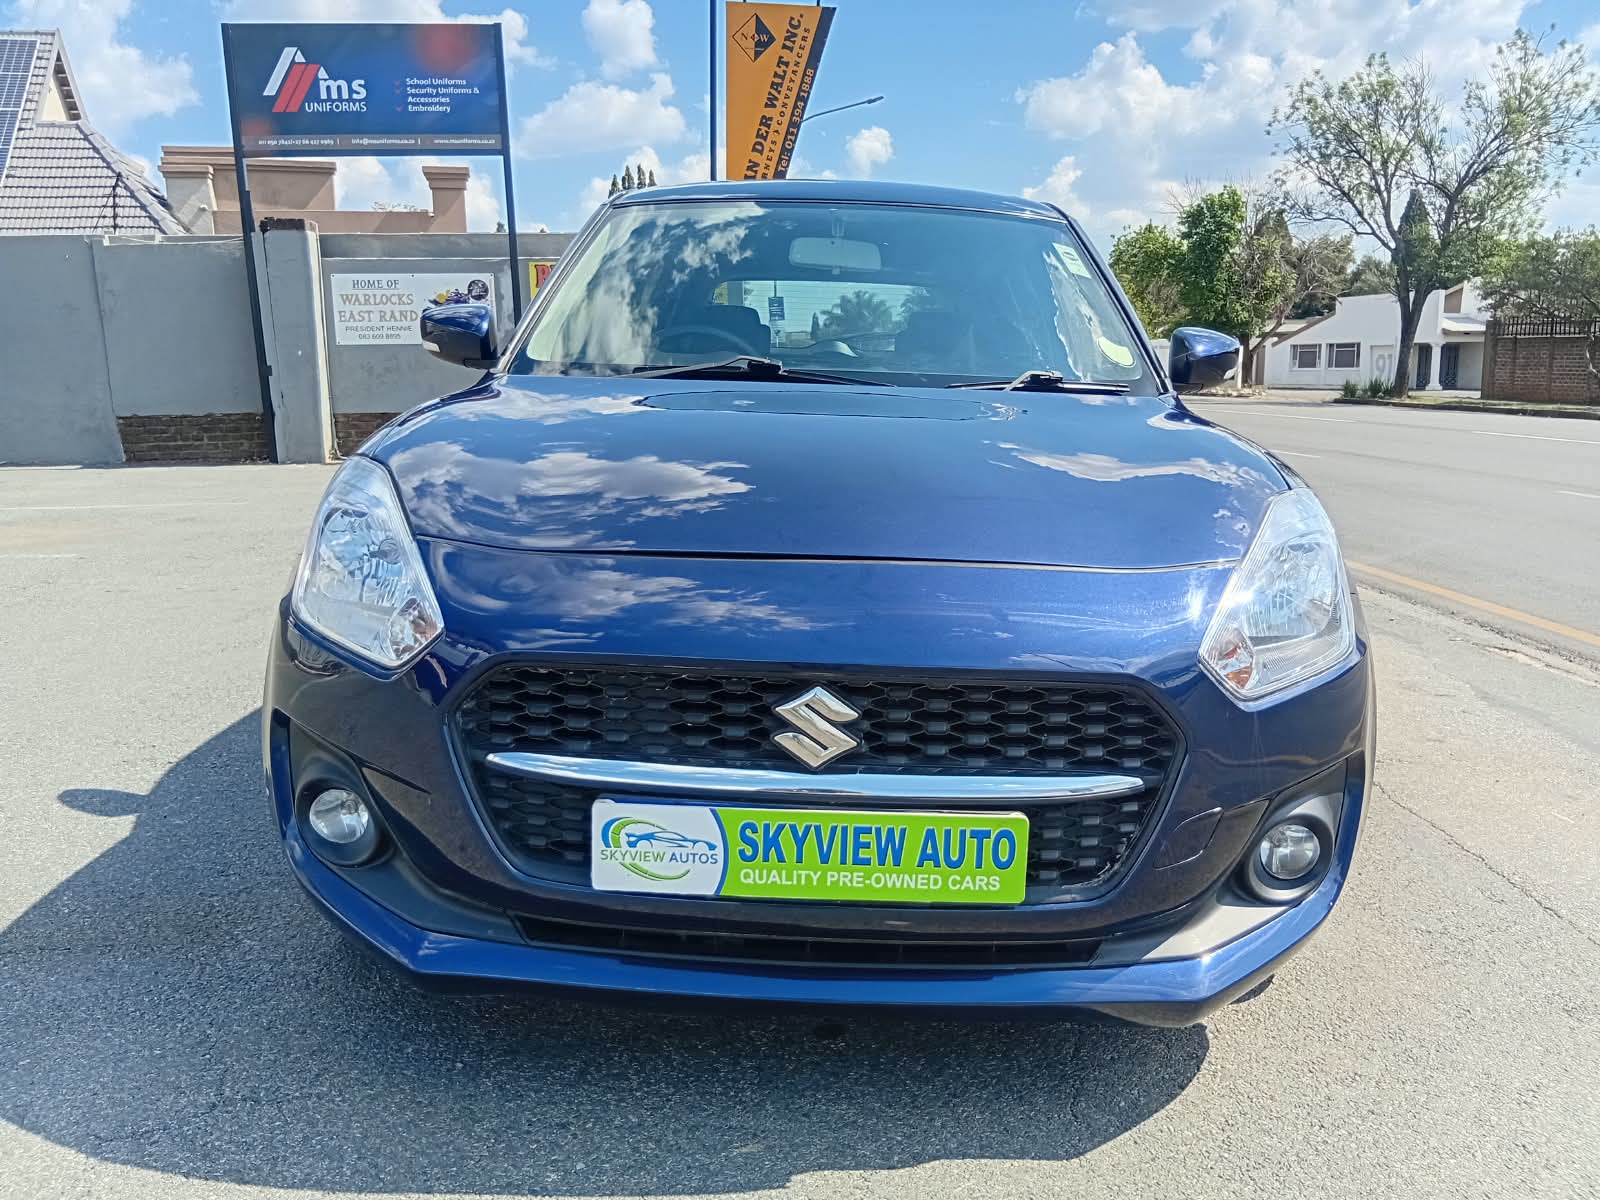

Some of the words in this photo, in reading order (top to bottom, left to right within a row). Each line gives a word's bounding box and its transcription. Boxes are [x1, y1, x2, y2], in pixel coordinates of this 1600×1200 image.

[406, 77, 431, 86] School
[432, 77, 467, 86] Uniforms
[777, 27, 811, 126] CONVEYANCERS
[800, 68, 815, 98] 1888
[407, 86, 437, 96] Security
[438, 87, 472, 95] Uniforms
[473, 87, 480, 95] &
[751, 114, 774, 156] DER
[764, 56, 791, 109] WALT
[781, 13, 805, 54] INC.
[305, 101, 367, 113] UNIFORMS
[408, 95, 450, 104] Accessories
[408, 104, 451, 113] Embroidery
[792, 101, 806, 125] 394
[784, 127, 798, 149] 011
[778, 152, 791, 173] Tel:
[352, 279, 384, 290] HOME
[386, 279, 400, 290] OF
[339, 293, 415, 306] WARLOCKS
[338, 310, 374, 323] EAST
[379, 309, 419, 323] RAND
[345, 325, 385, 333] PRESIDENT
[737, 820, 908, 868] SKYVIEW
[916, 826, 1017, 871] AUTO
[600, 849, 666, 863] SKYVIEW
[668, 852, 719, 865] AUTOS
[740, 868, 821, 886] QUALITY
[826, 871, 942, 889] PRE-OWNED
[948, 875, 1001, 891] CARS
